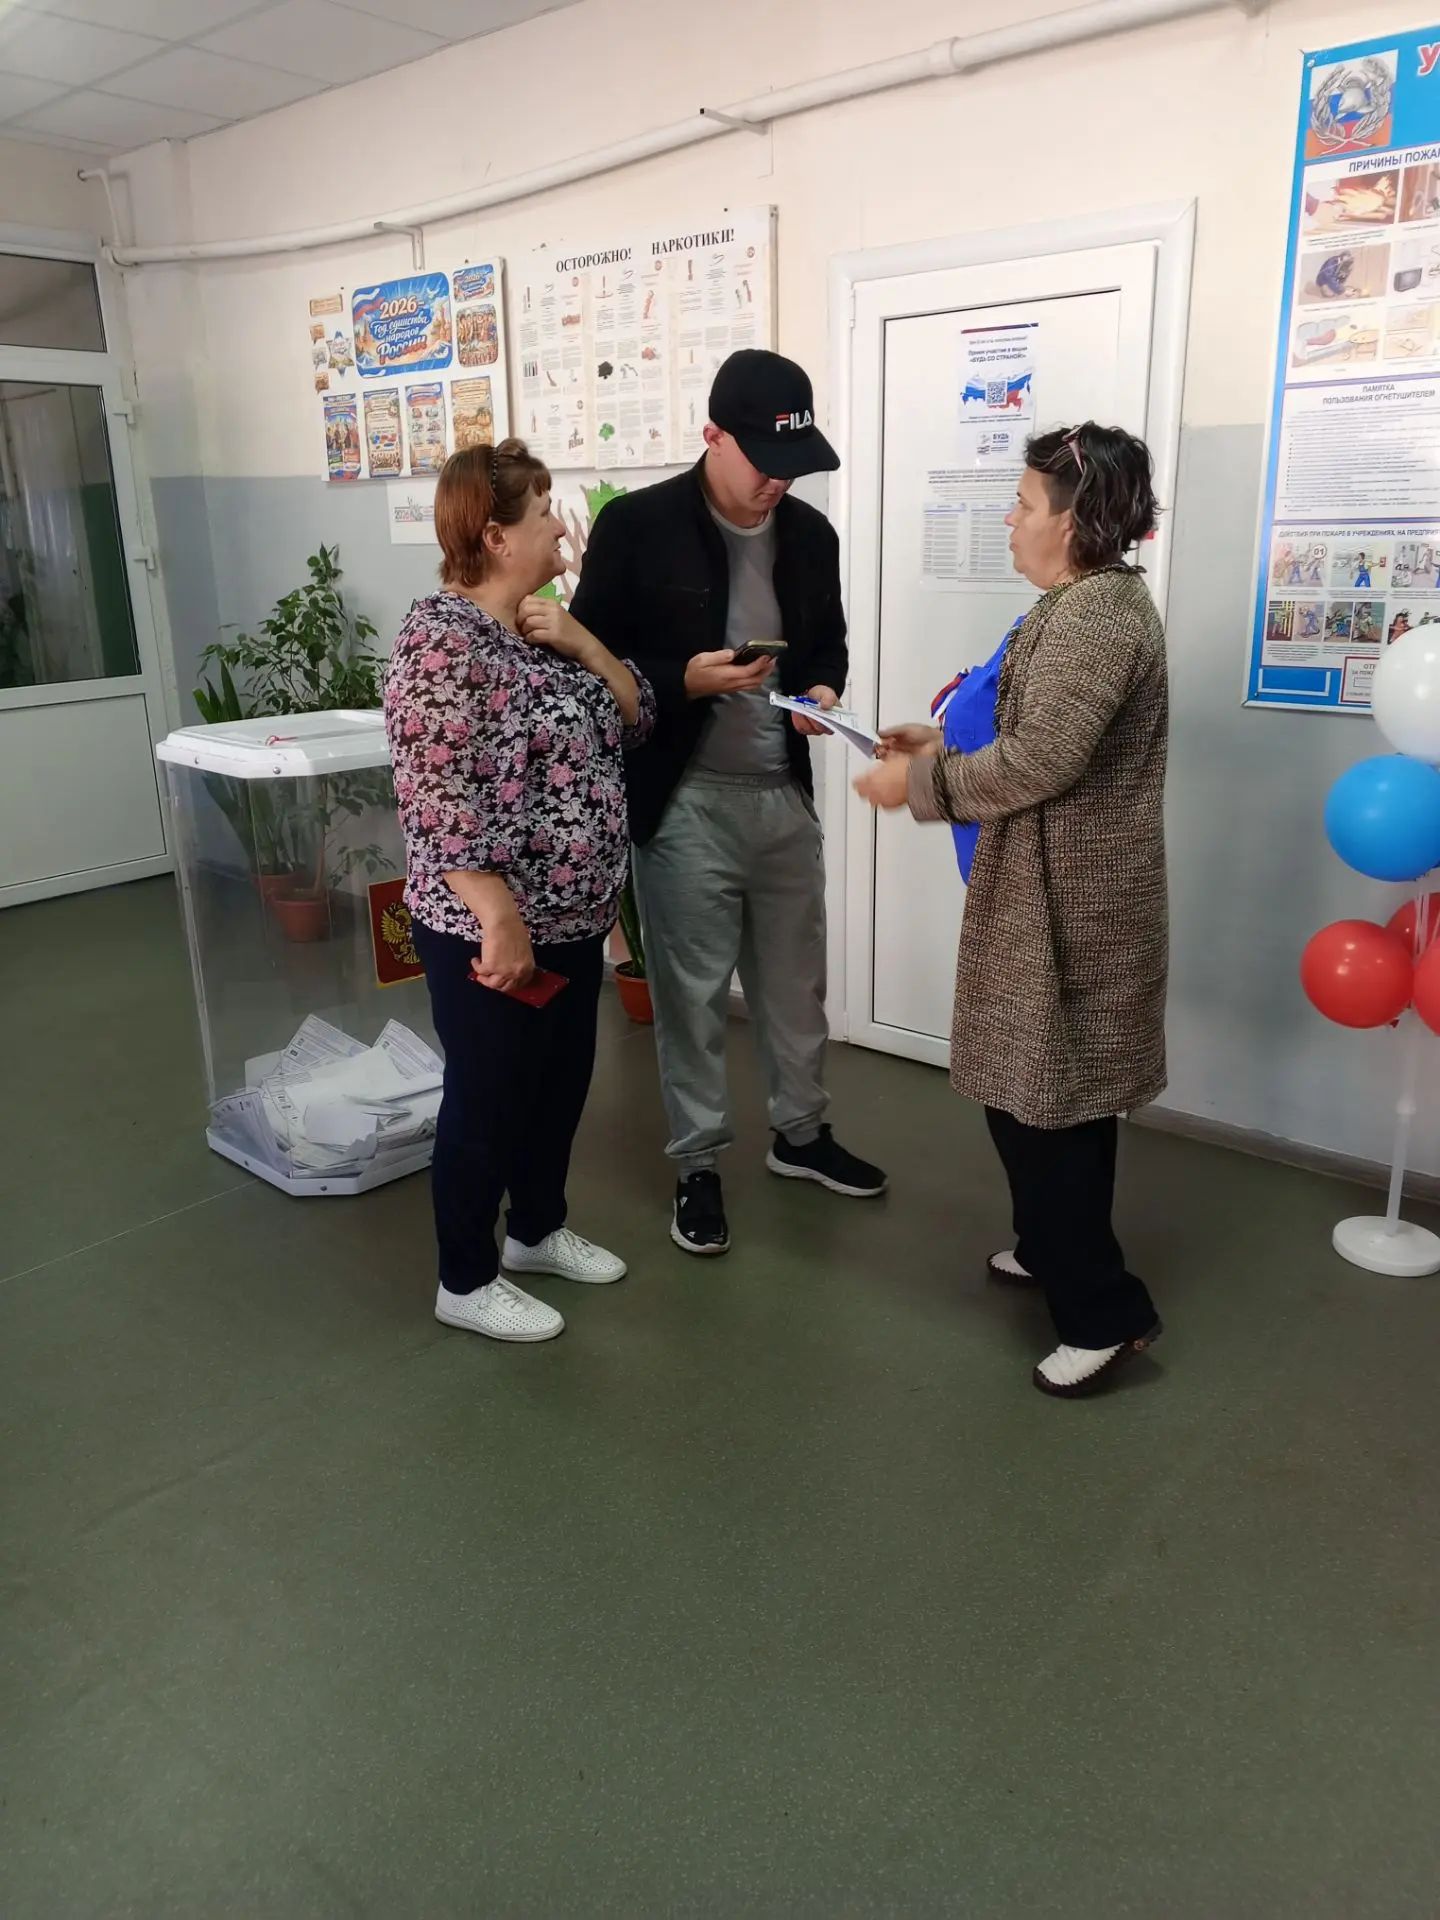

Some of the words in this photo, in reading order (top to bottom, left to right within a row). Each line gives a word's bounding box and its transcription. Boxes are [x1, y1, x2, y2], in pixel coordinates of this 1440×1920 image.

[1349, 154, 1402, 172] ПРИЧИНЫ
[556, 248, 632, 273] ОСТОРОЖНО!
[652, 228, 735, 255] НАРКОТИКИ!
[1362, 384, 1395, 392] ПАМЯТКА
[1375, 390, 1436, 401] ОГНЕТУШИТЕЛЕМ
[776, 410, 813, 432] FILA
